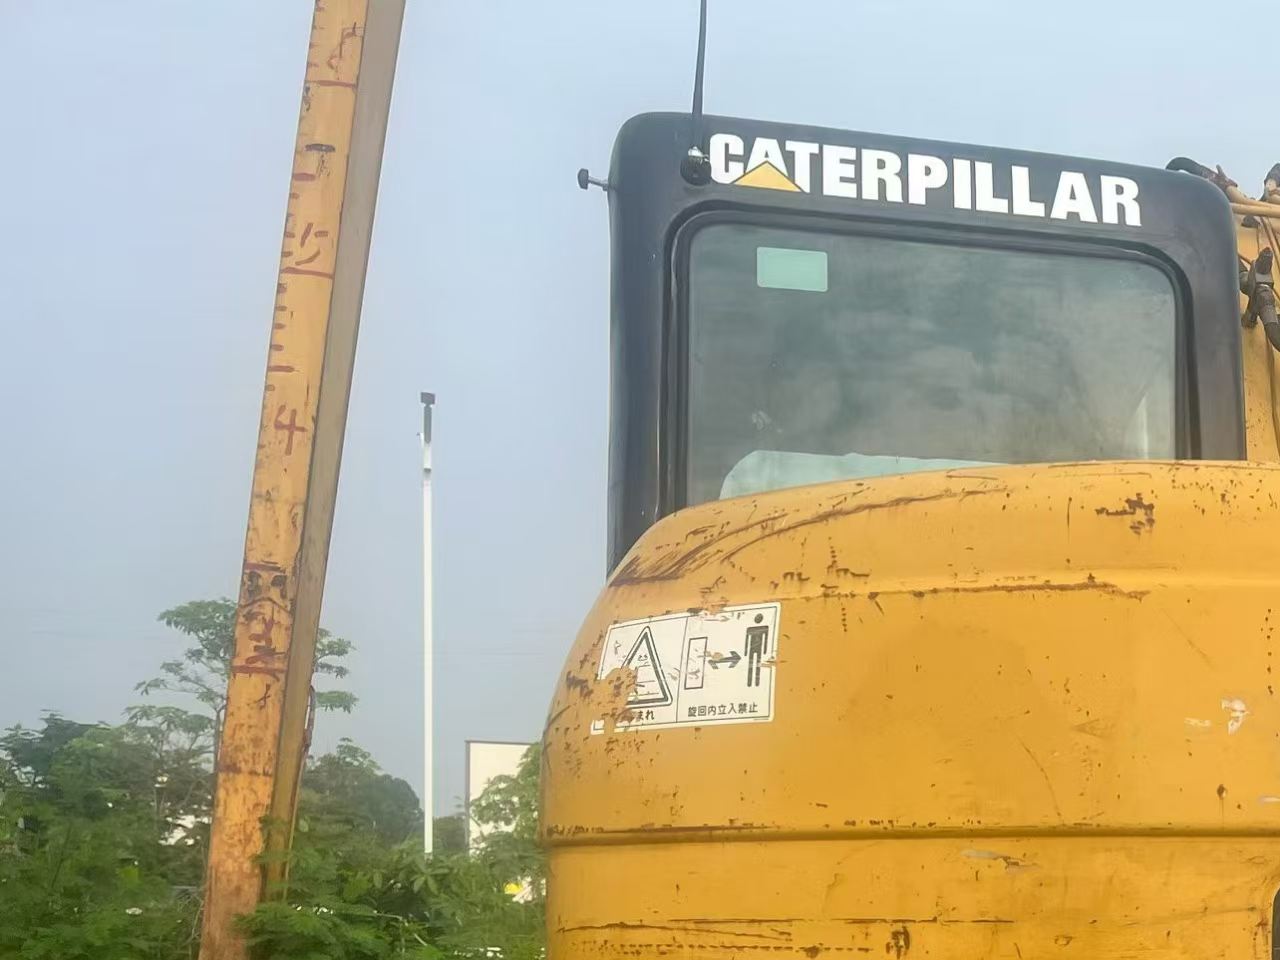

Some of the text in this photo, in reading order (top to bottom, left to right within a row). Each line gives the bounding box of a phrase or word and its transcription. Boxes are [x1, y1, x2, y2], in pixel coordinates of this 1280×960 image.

[709, 133, 1142, 227] CATERPILLAR
[273, 404, 308, 456] 4
[687, 702, 758, 717] 旋回内立入禁止
